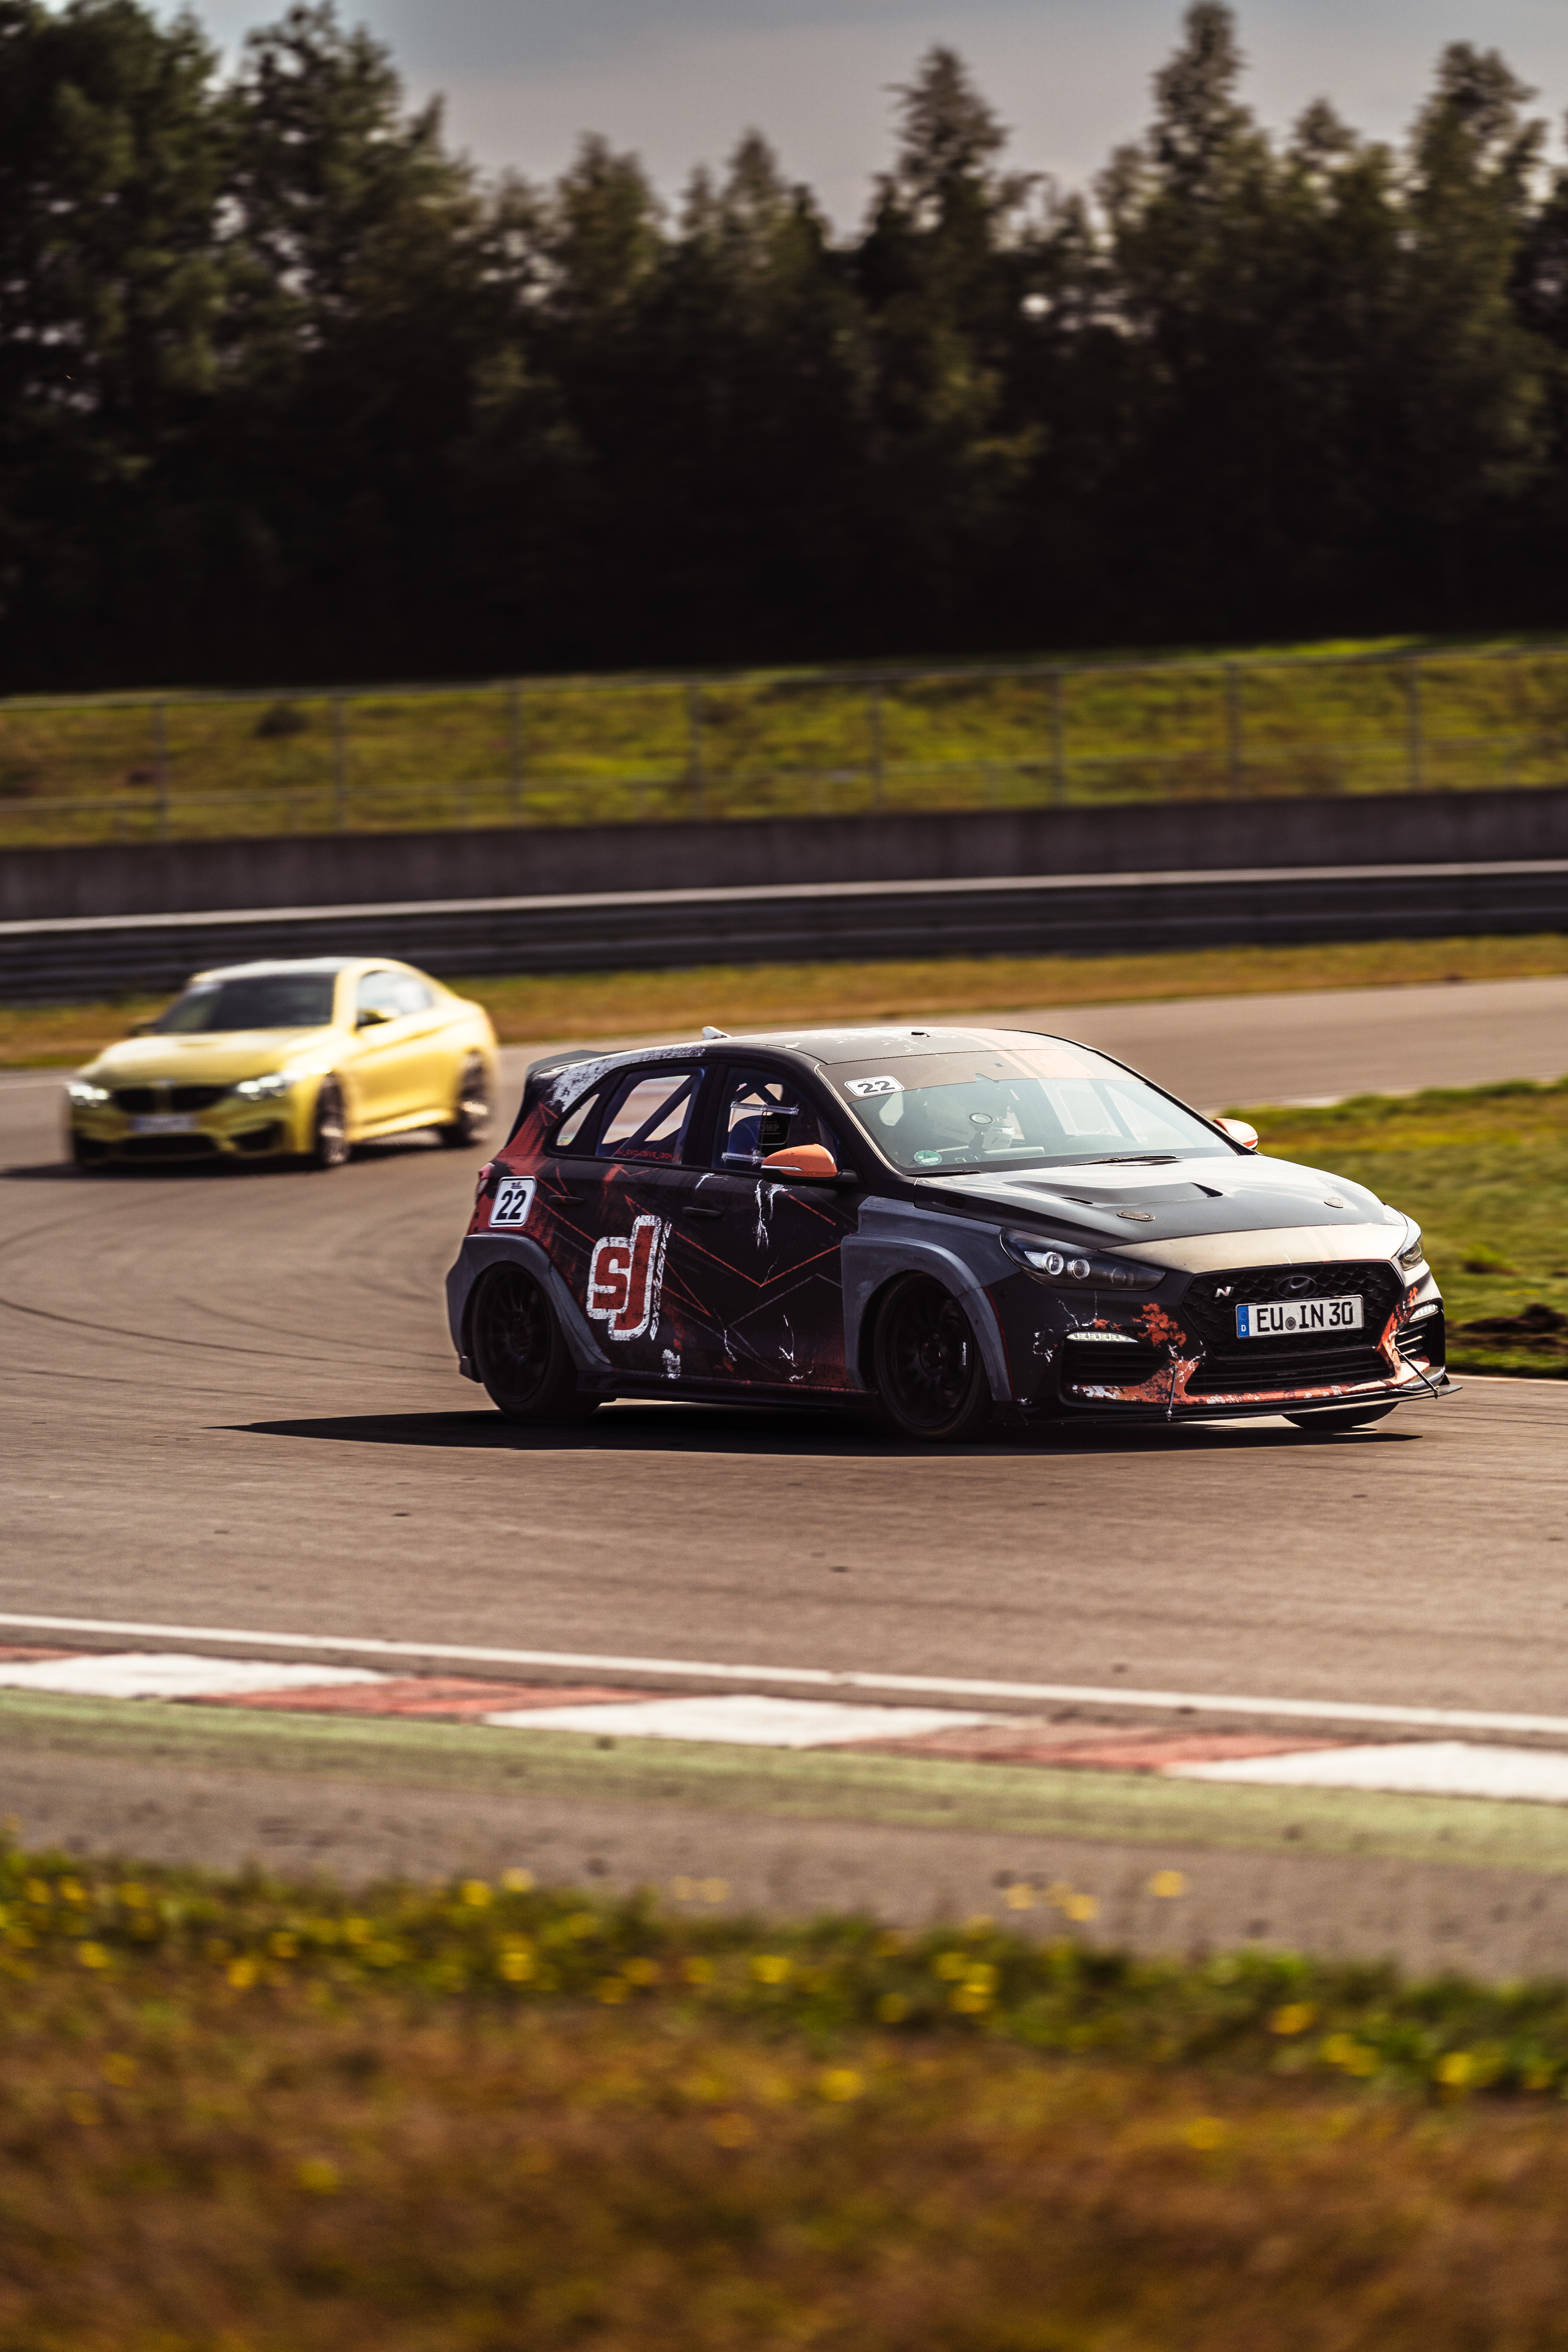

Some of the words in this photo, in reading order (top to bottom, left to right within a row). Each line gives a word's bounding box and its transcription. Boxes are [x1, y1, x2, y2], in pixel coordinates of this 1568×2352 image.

[858, 1081, 895, 1093] 22
[494, 1190, 527, 1220] 22
[1215, 1286, 1233, 1297] N
[1256, 1307, 1284, 1332] EU
[1299, 1304, 1324, 1329] IN
[1329, 1301, 1354, 1325] 30
